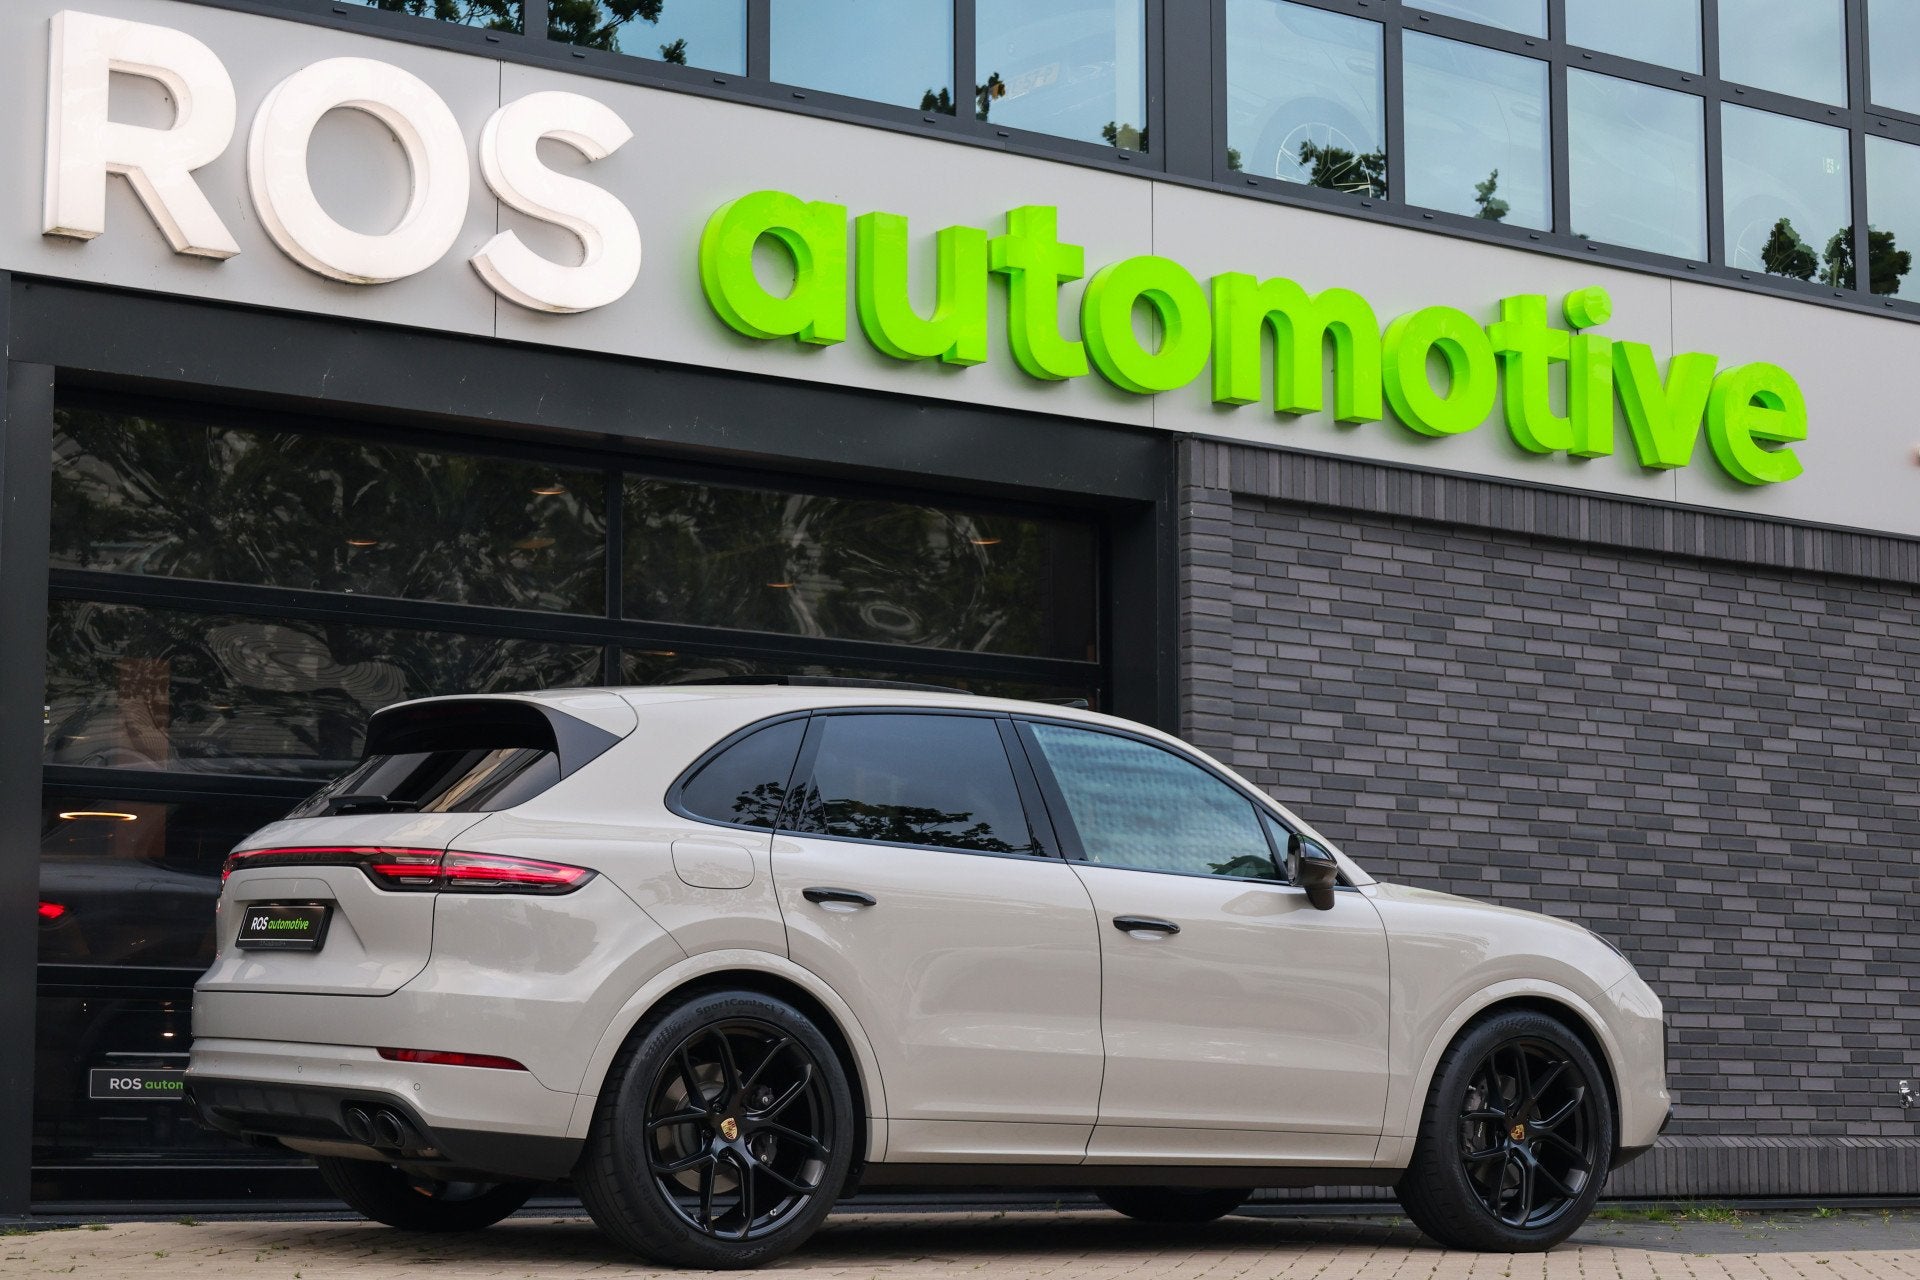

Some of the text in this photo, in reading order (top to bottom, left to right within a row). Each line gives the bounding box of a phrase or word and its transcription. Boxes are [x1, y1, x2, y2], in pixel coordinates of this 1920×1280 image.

[42, 9, 1808, 485] ROS automotive
[251, 916, 310, 930] ROS automotive
[697, 998, 776, 1015] SportContact
[109, 1077, 142, 1090] ROS
